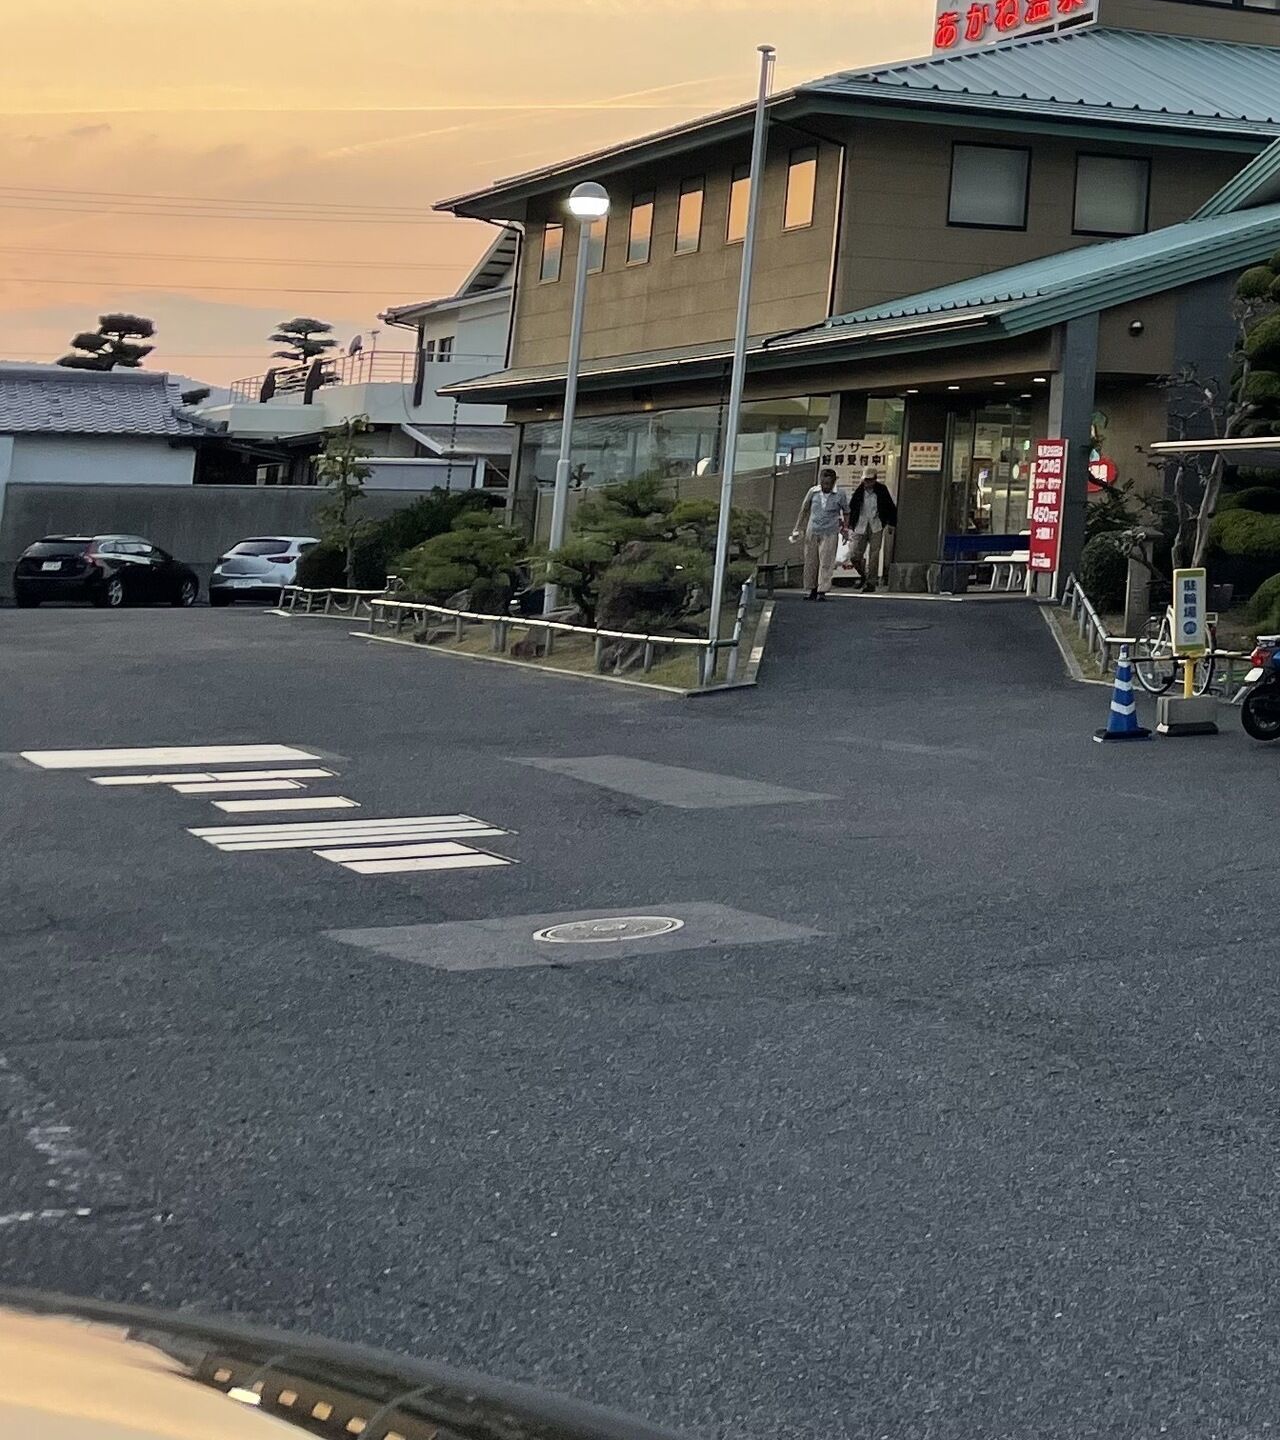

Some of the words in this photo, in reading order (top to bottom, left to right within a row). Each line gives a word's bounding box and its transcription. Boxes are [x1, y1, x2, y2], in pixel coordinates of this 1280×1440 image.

[823, 442, 886, 453] マッサージ
